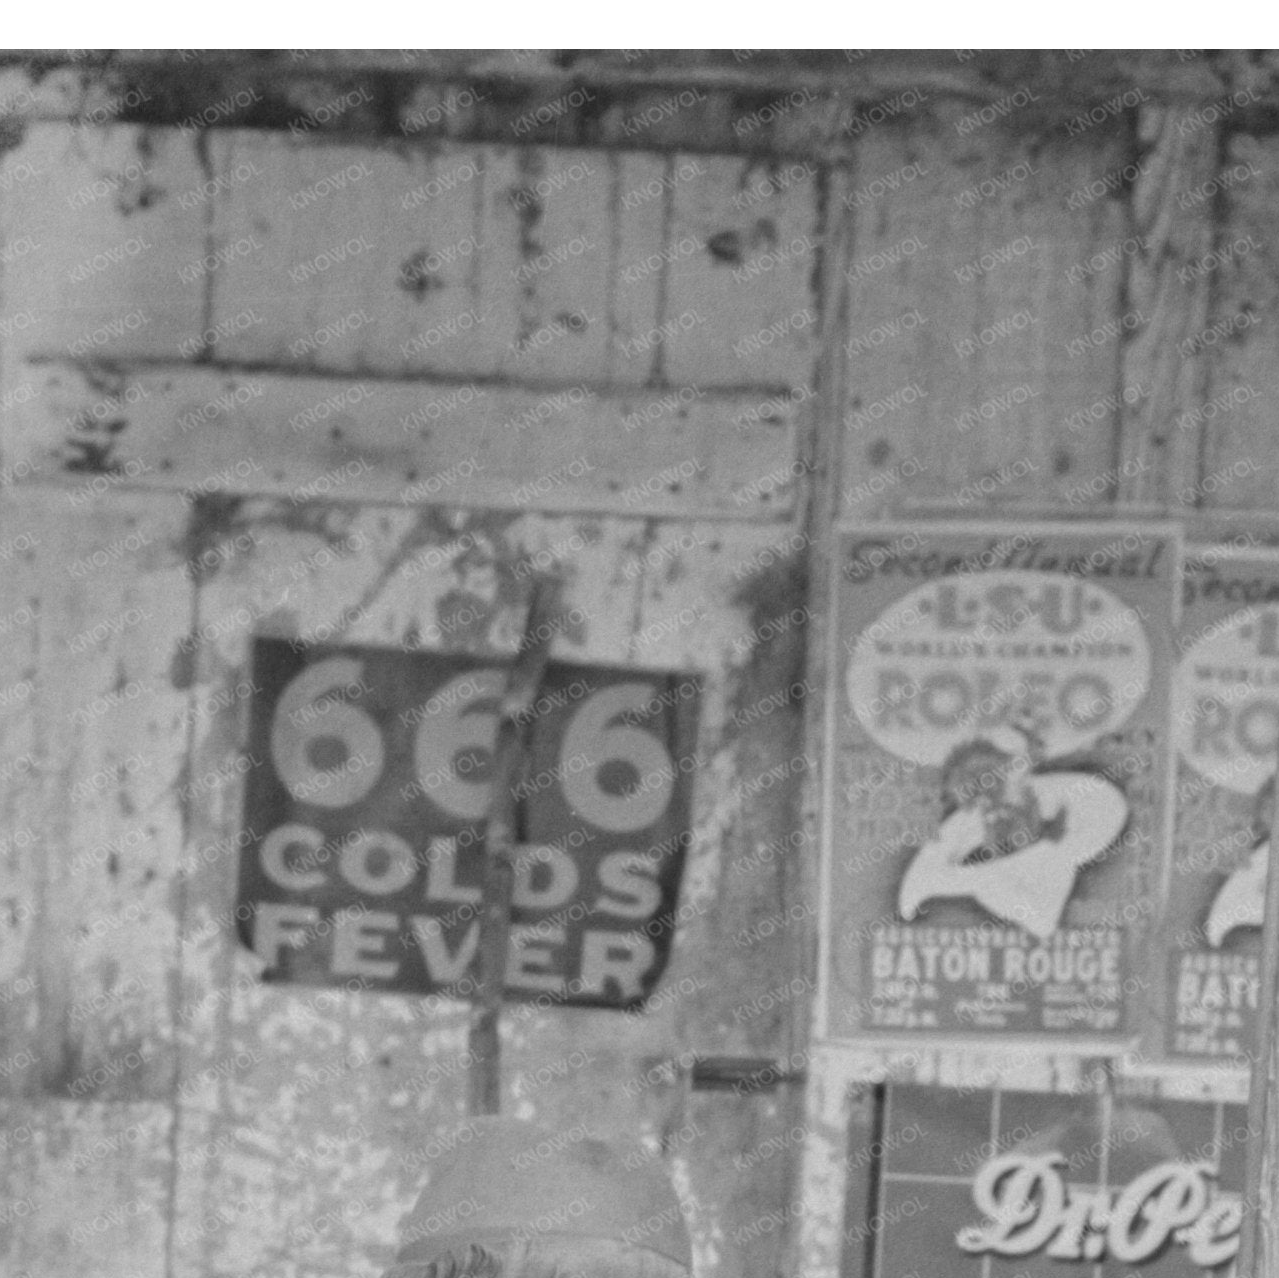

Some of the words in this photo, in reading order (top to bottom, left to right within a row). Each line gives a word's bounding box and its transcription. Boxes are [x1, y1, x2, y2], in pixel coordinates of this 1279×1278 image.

[258, 822, 663, 919] COLDS
[251, 901, 656, 998] FEVER
[872, 945, 991, 983] BATON
[1004, 946, 1121, 983] ROUGE
